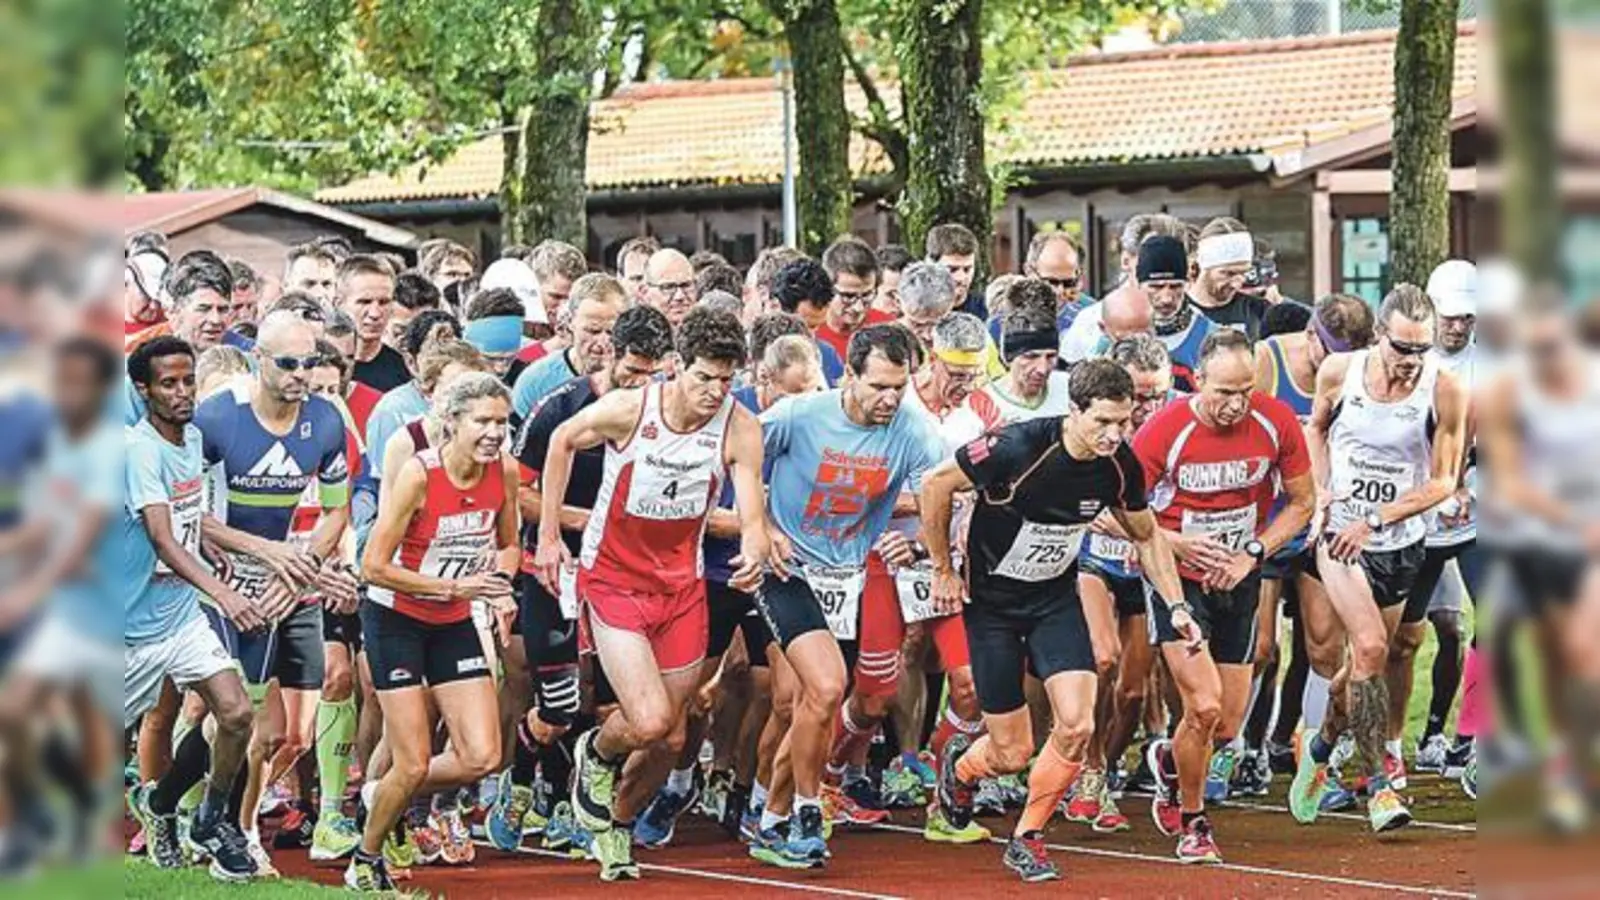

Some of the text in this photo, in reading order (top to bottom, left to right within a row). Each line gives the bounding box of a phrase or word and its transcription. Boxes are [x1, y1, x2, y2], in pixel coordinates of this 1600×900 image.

[662, 480, 678, 499] 4
[1352, 478, 1397, 503] 209
[1024, 544, 1068, 563] 725
